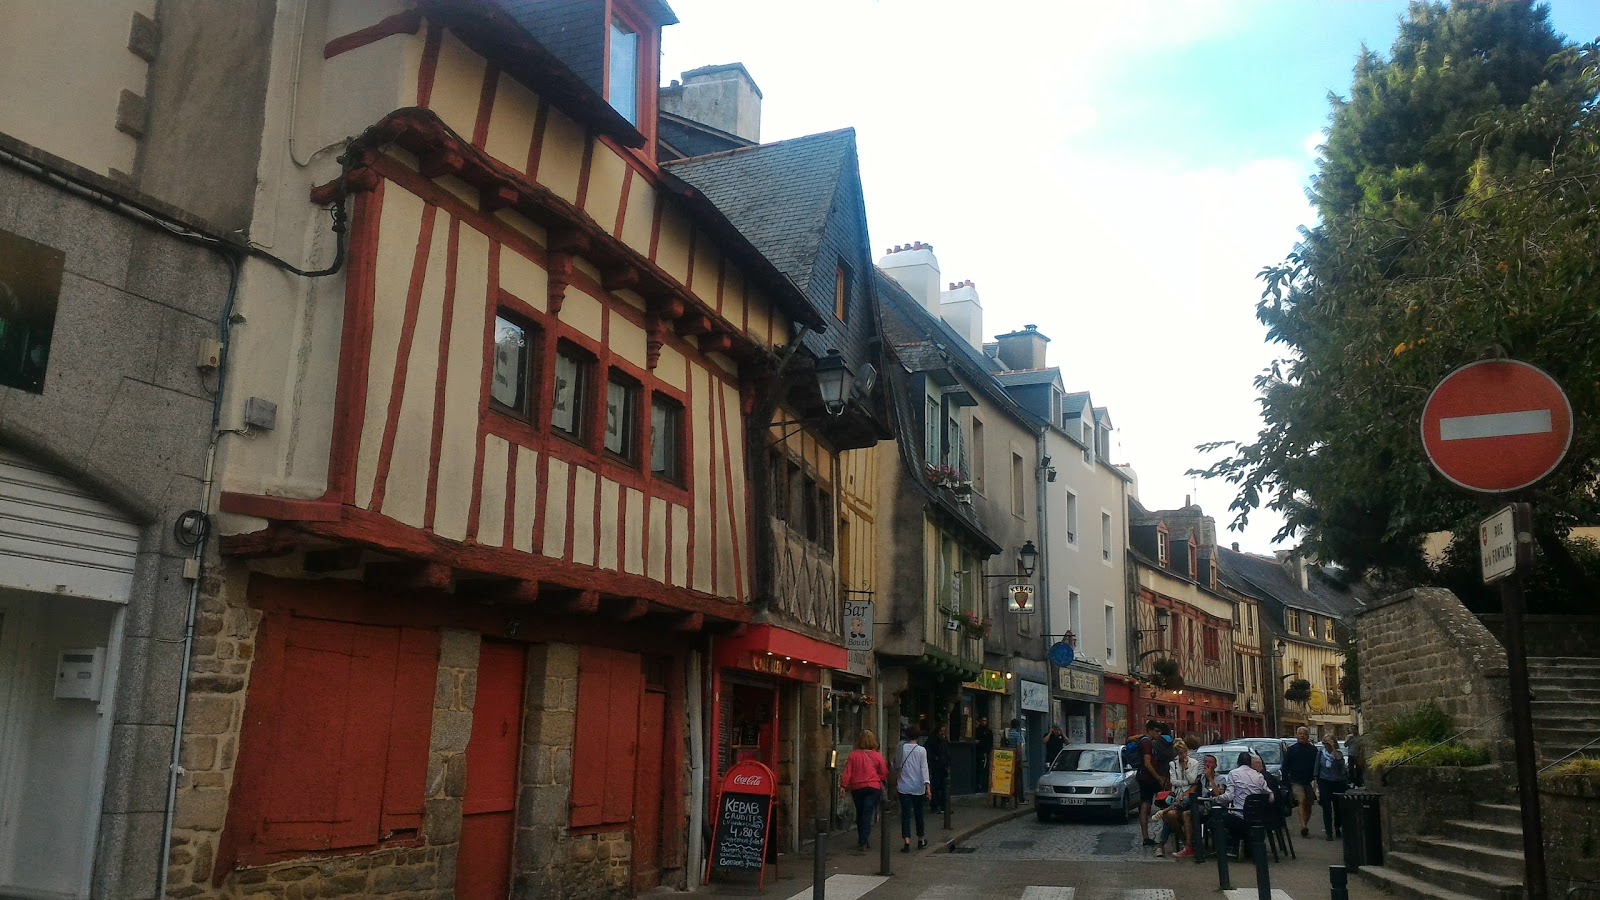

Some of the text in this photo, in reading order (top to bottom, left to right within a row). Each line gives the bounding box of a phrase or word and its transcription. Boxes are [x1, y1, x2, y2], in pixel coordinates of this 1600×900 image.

[1494, 522, 1503, 538] RUE
[1492, 542, 1512, 564] FONTAINE
[843, 601, 868, 617] Bar
[725, 798, 760, 815] KEBAB
[730, 825, 760, 838] 4,80€
